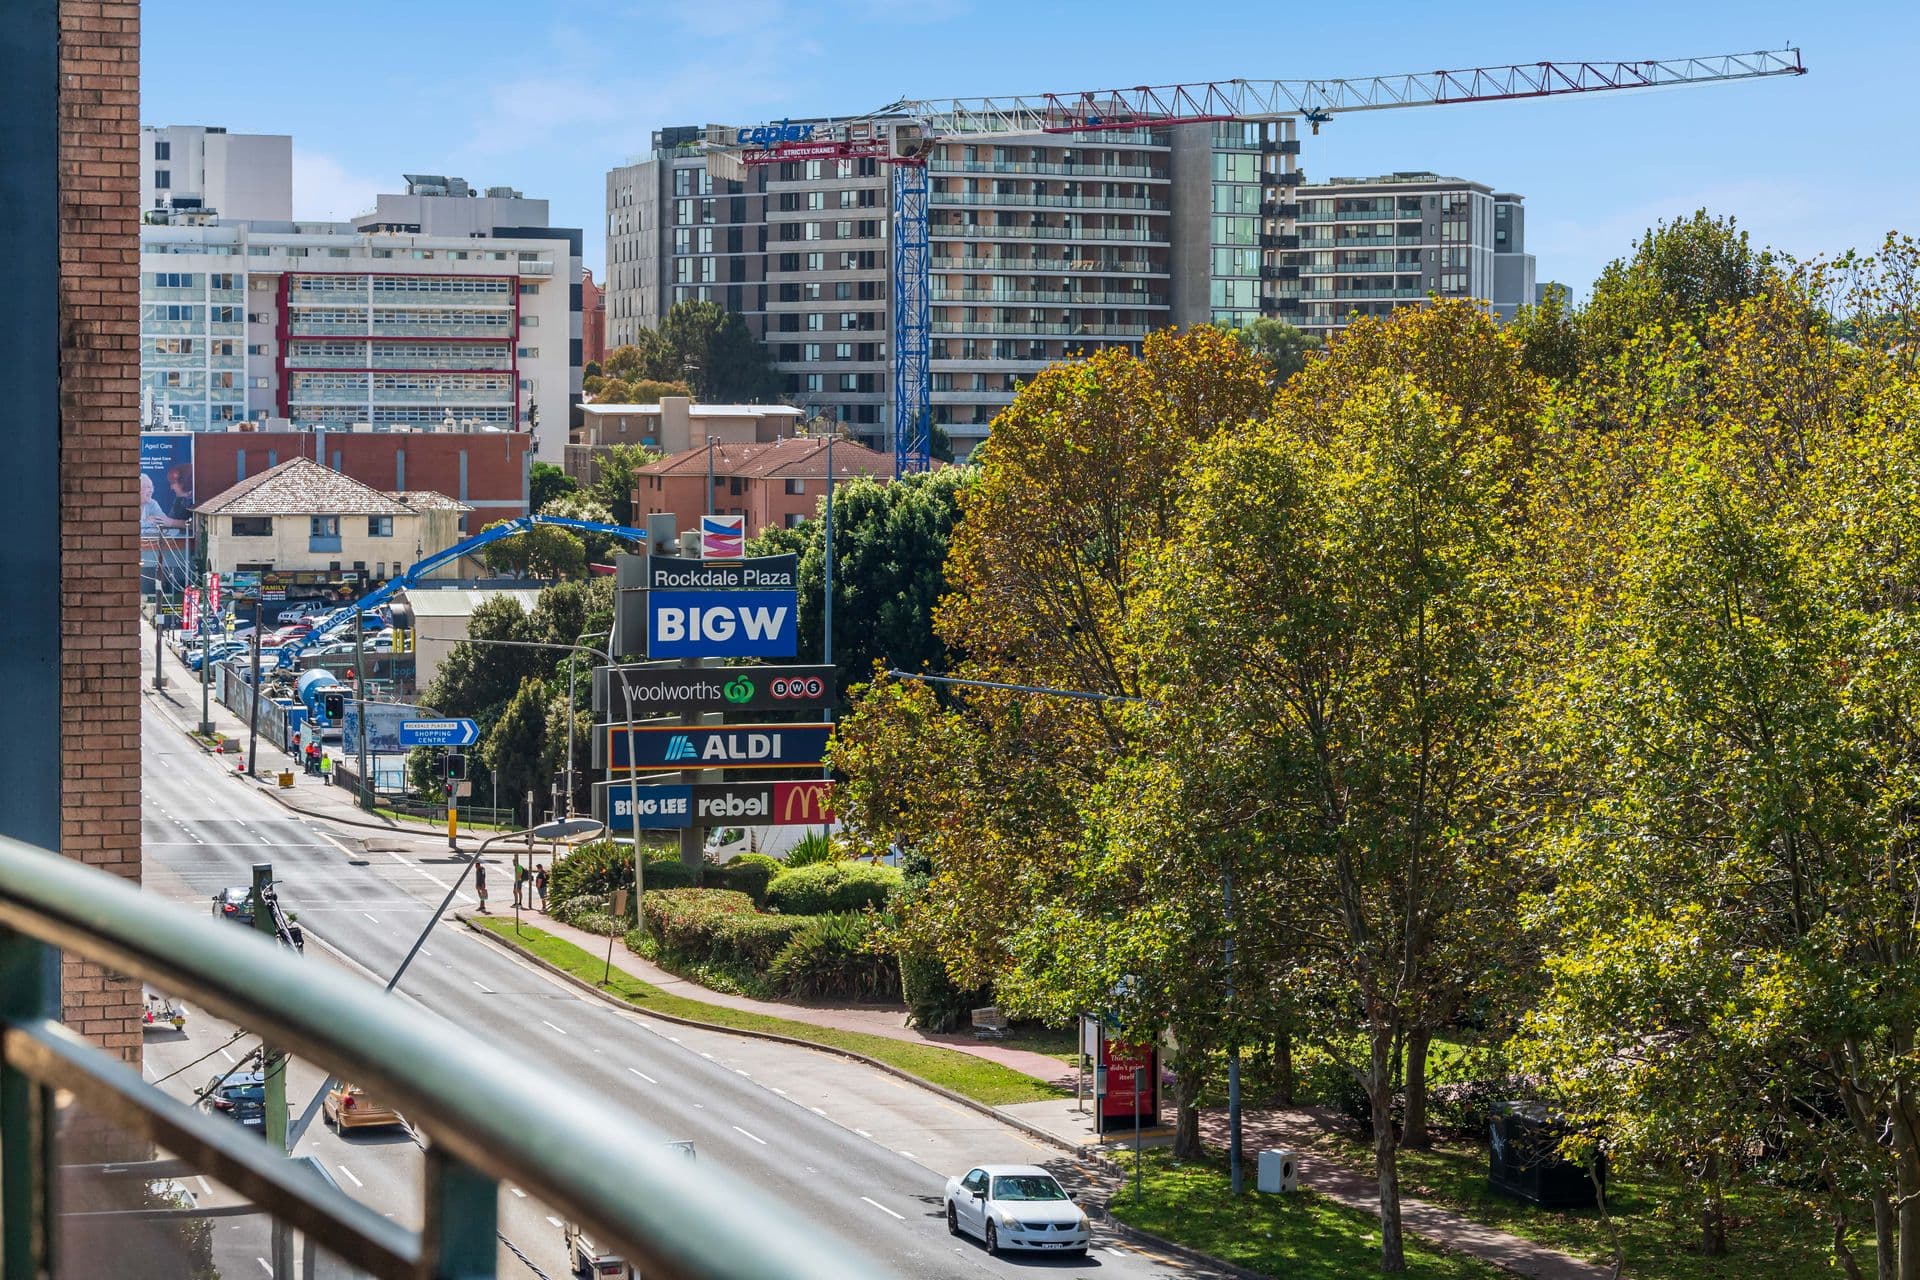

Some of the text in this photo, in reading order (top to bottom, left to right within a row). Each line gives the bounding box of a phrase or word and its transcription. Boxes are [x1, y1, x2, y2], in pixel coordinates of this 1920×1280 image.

[783, 146, 835, 156] STRICTLY CRANES
[654, 569, 791, 586] Rockdale Plaza
[702, 734, 781, 760] ALDI
[615, 798, 687, 816] BING LEE
[698, 792, 768, 817] rebel
